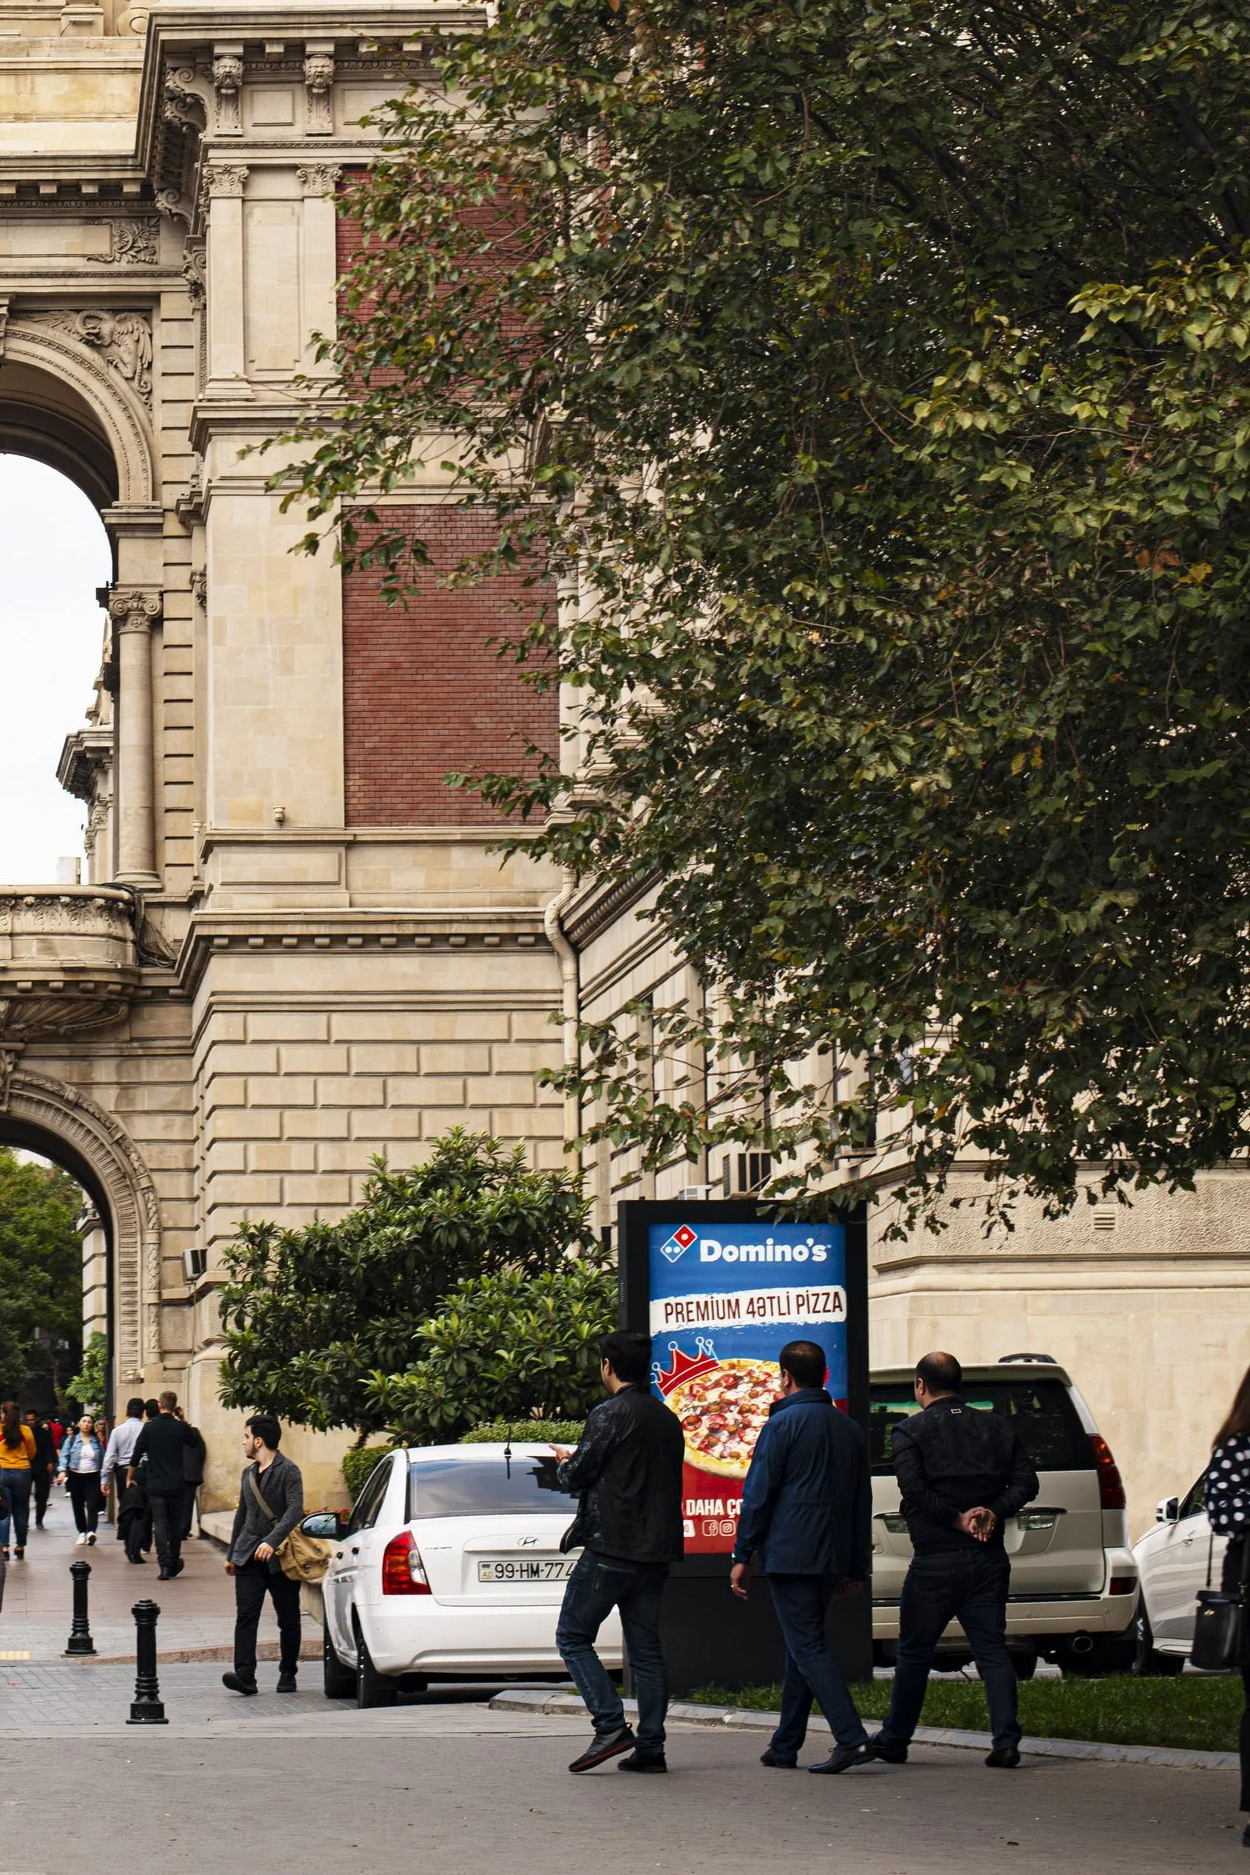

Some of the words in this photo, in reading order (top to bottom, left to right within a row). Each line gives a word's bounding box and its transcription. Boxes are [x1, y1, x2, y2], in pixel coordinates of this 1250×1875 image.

[699, 1237, 828, 1263] Domino's
[664, 1295, 741, 1324] PREMİUM
[795, 1289, 843, 1315] PİZZA
[686, 1498, 725, 1516] DAHA
